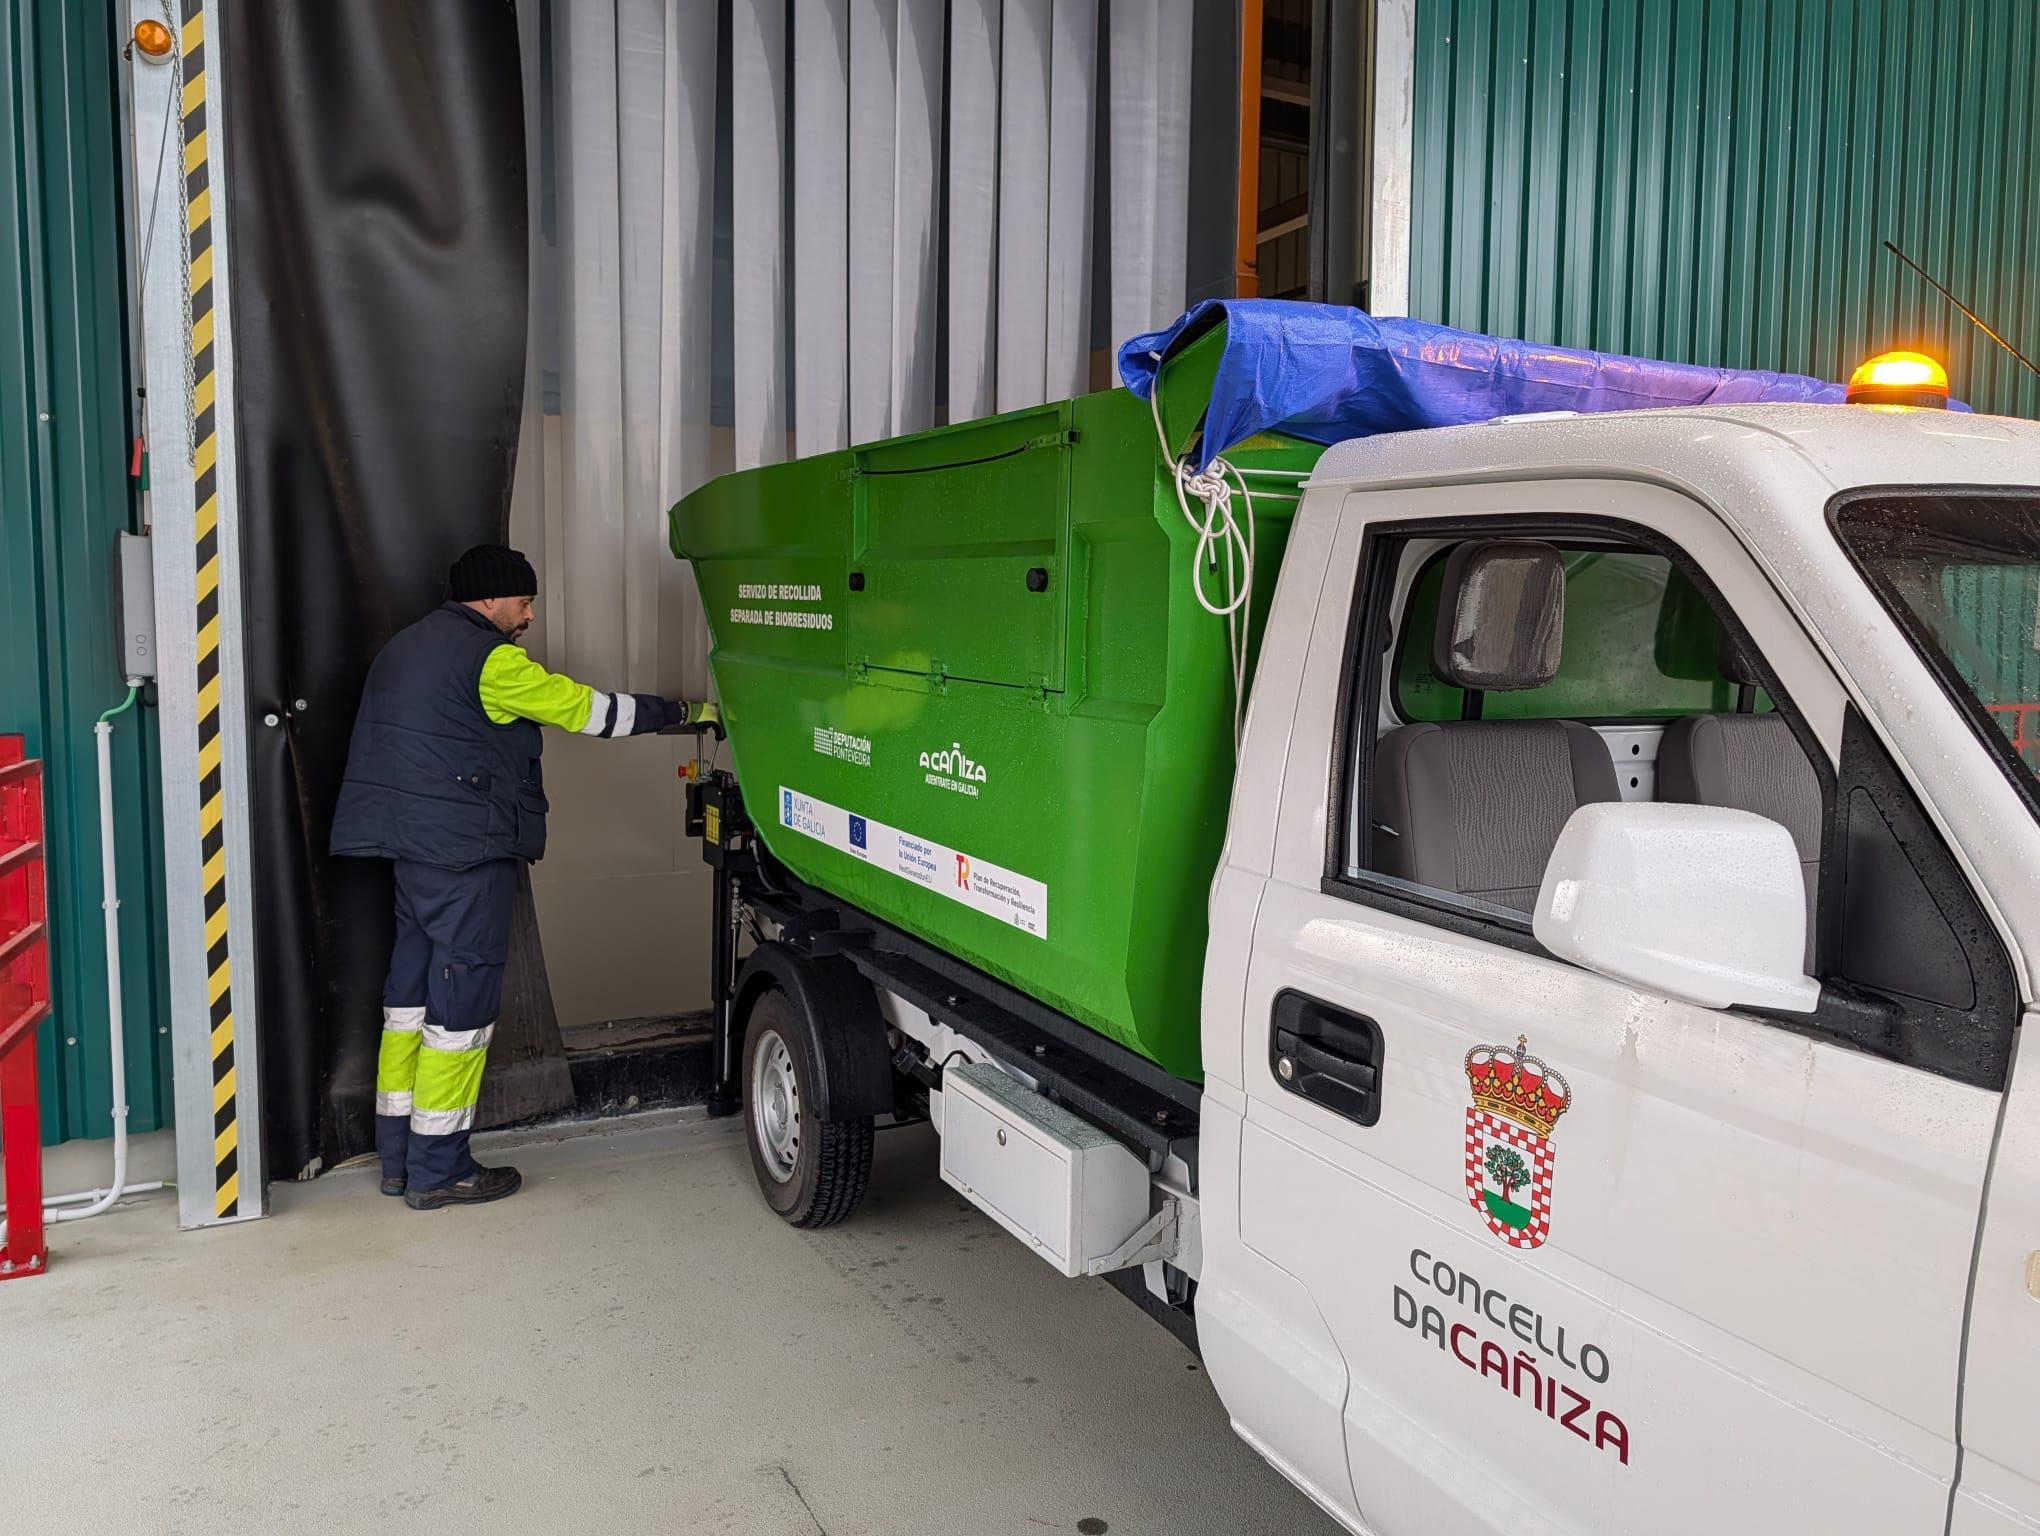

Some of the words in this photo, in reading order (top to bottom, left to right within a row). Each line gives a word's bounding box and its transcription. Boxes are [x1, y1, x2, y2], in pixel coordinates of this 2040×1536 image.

[738, 584, 767, 599] SERVIZO
[768, 584, 778, 599] DE
[779, 585, 822, 601] RECOLLIDA
[730, 608, 763, 625] SEPARADA
[764, 610, 774, 626] DE
[775, 611, 833, 630] BIORRESIDUOS
[834, 731, 871, 754] DEPUTACIÓN
[834, 745, 871, 768] PONTEVEDRA
[794, 796, 813, 816] XUNTA
[794, 813, 802, 827] DE
[802, 816, 826, 838] GALICIA
[898, 836, 923, 853] Financiado
[1410, 1248, 1610, 1385] CONCELLO
